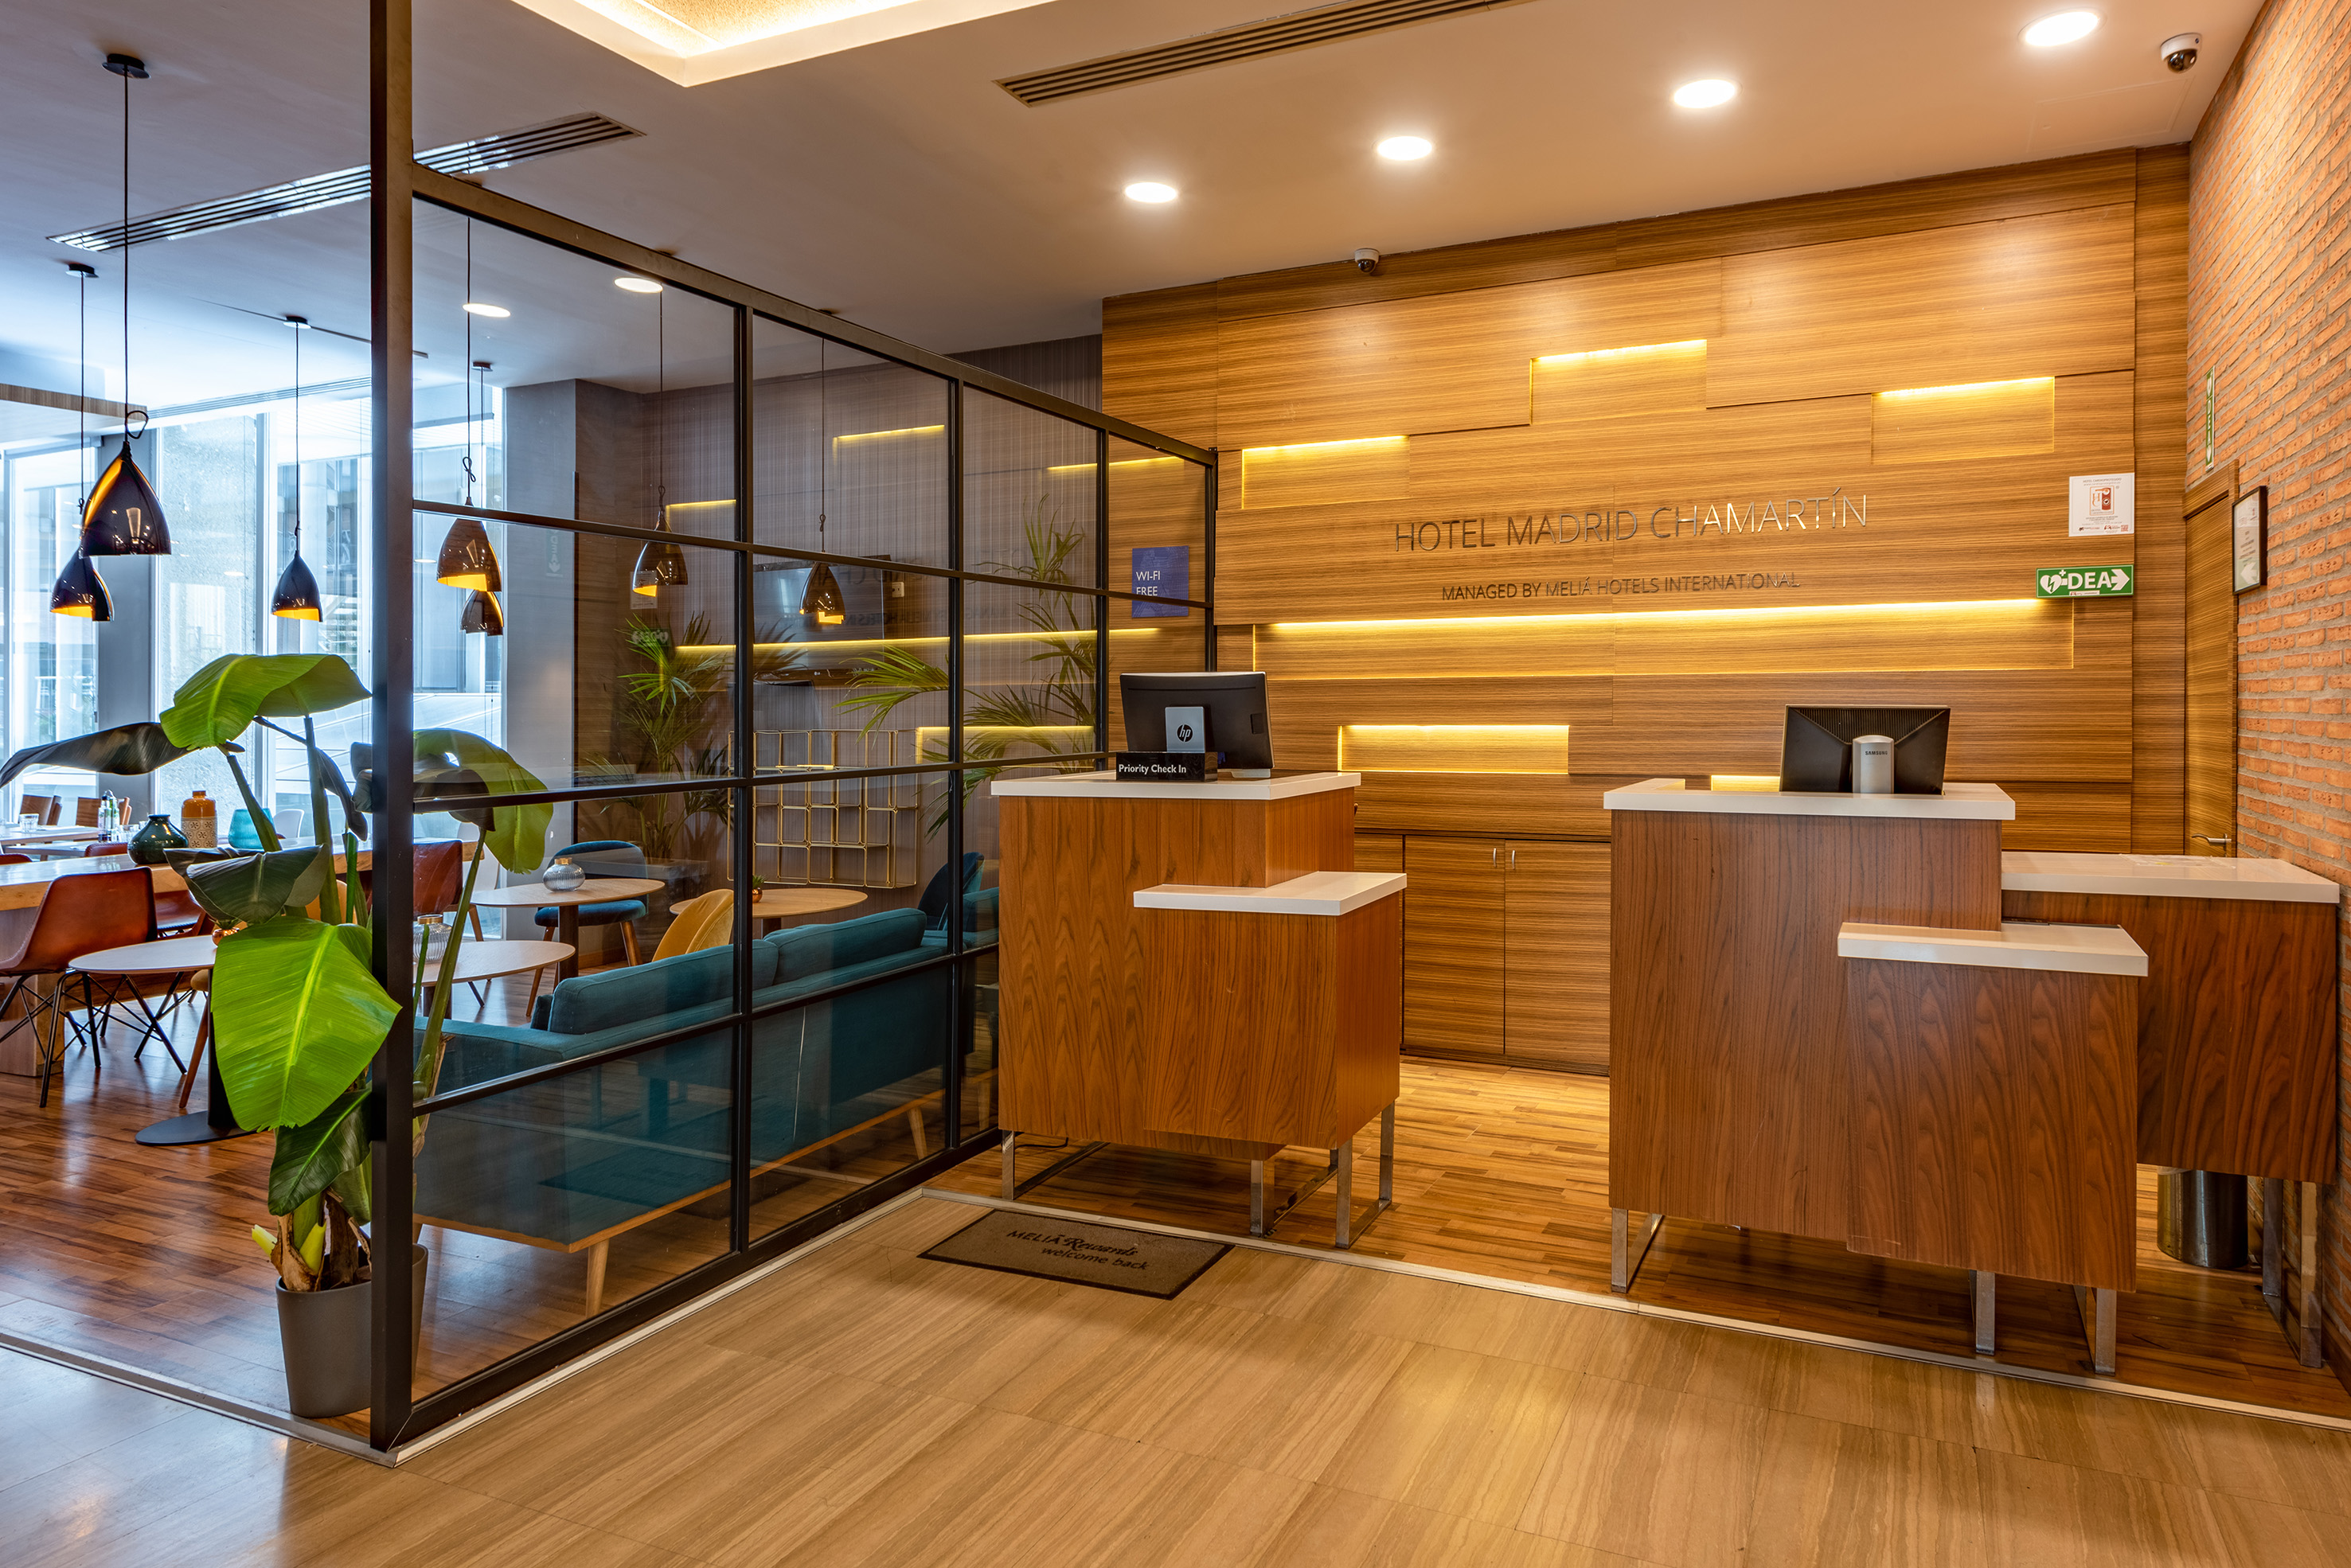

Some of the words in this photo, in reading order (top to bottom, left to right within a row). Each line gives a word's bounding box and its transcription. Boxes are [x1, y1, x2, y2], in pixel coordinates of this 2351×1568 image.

[1395, 517, 1496, 552] HOTEL
[1507, 509, 1638, 546] MADRID
[1650, 486, 1867, 538] CHAMARTÍN
[1135, 570, 1161, 581] WI-FI
[2068, 571, 2112, 590] DEA
[1136, 586, 1158, 596] FREE
[1441, 583, 1517, 601] MANAGED
[1521, 582, 1542, 598] BY
[1545, 576, 1592, 596] MELIÁ
[1596, 577, 1660, 595] HOTELS
[1664, 571, 1801, 593] INTERNATIONAL
[1119, 764, 1149, 774] Priority
[1150, 764, 1177, 773] Check
[1178, 764, 1187, 773] In
[1041, 1247, 1108, 1264] welcome
[1111, 1258, 1150, 1270] back
